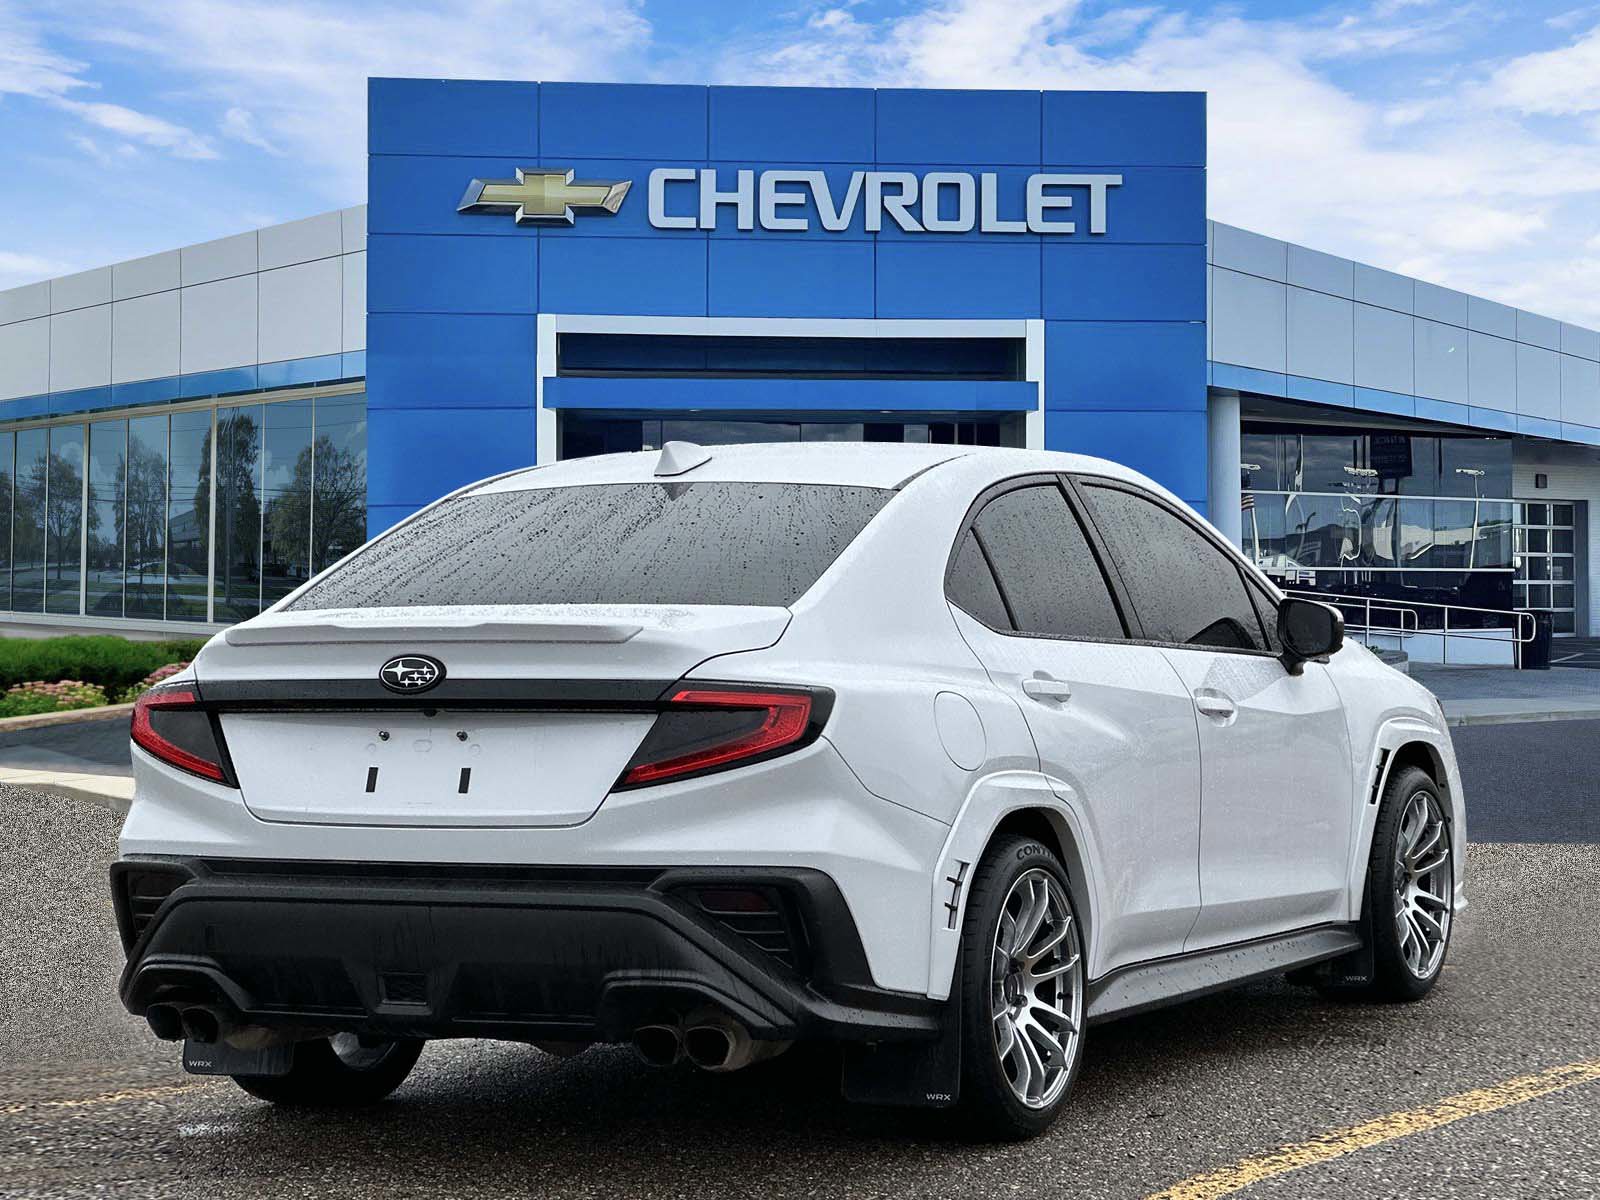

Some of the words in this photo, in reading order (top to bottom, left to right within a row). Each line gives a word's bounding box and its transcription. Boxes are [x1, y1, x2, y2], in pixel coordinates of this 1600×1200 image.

[648, 168, 1123, 234] CHEVROLET
[188, 1060, 212, 1068] WRX
[926, 1093, 951, 1101] WRX
